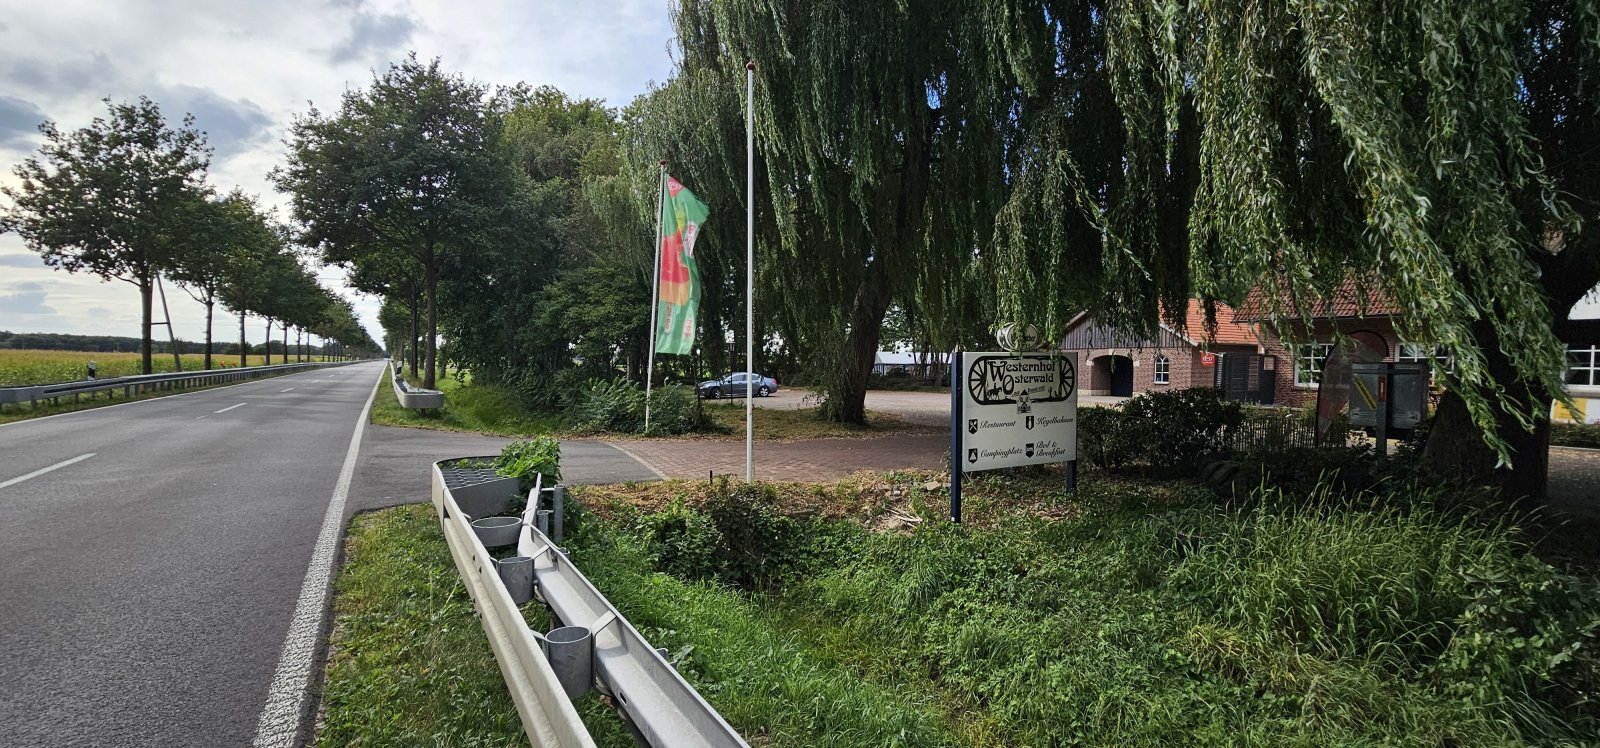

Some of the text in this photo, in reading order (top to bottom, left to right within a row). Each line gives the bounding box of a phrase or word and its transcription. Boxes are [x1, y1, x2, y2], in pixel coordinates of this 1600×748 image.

[987, 361, 1056, 382] Westernhof
[1002, 373, 1054, 395] Osterwald
[980, 420, 1017, 429] Restaurant
[1036, 440, 1050, 449] Bed
[980, 446, 1023, 459] Campingplatz
[1036, 448, 1066, 458] Breakfast
